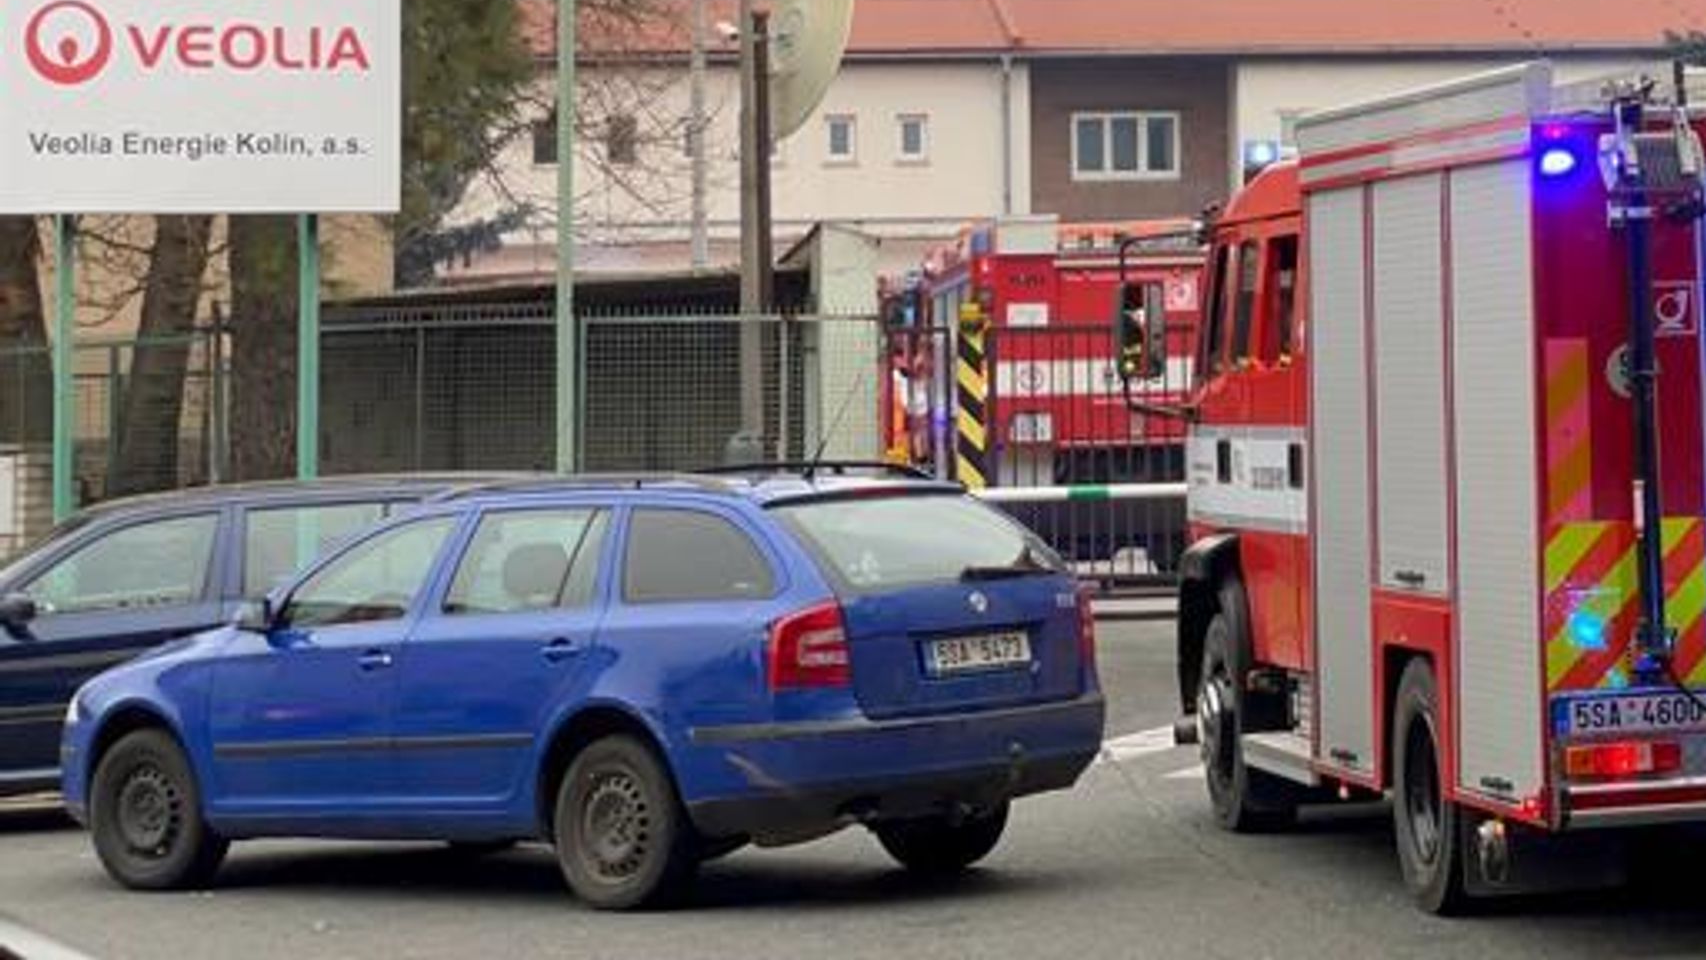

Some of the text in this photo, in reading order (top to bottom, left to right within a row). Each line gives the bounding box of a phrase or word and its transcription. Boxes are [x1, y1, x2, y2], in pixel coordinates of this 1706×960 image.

[126, 24, 370, 71] VEOLIA
[29, 132, 112, 156] Veolia
[122, 132, 227, 161] Energie
[322, 137, 367, 156] a.s.
[1574, 700, 1622, 729] 5SA
